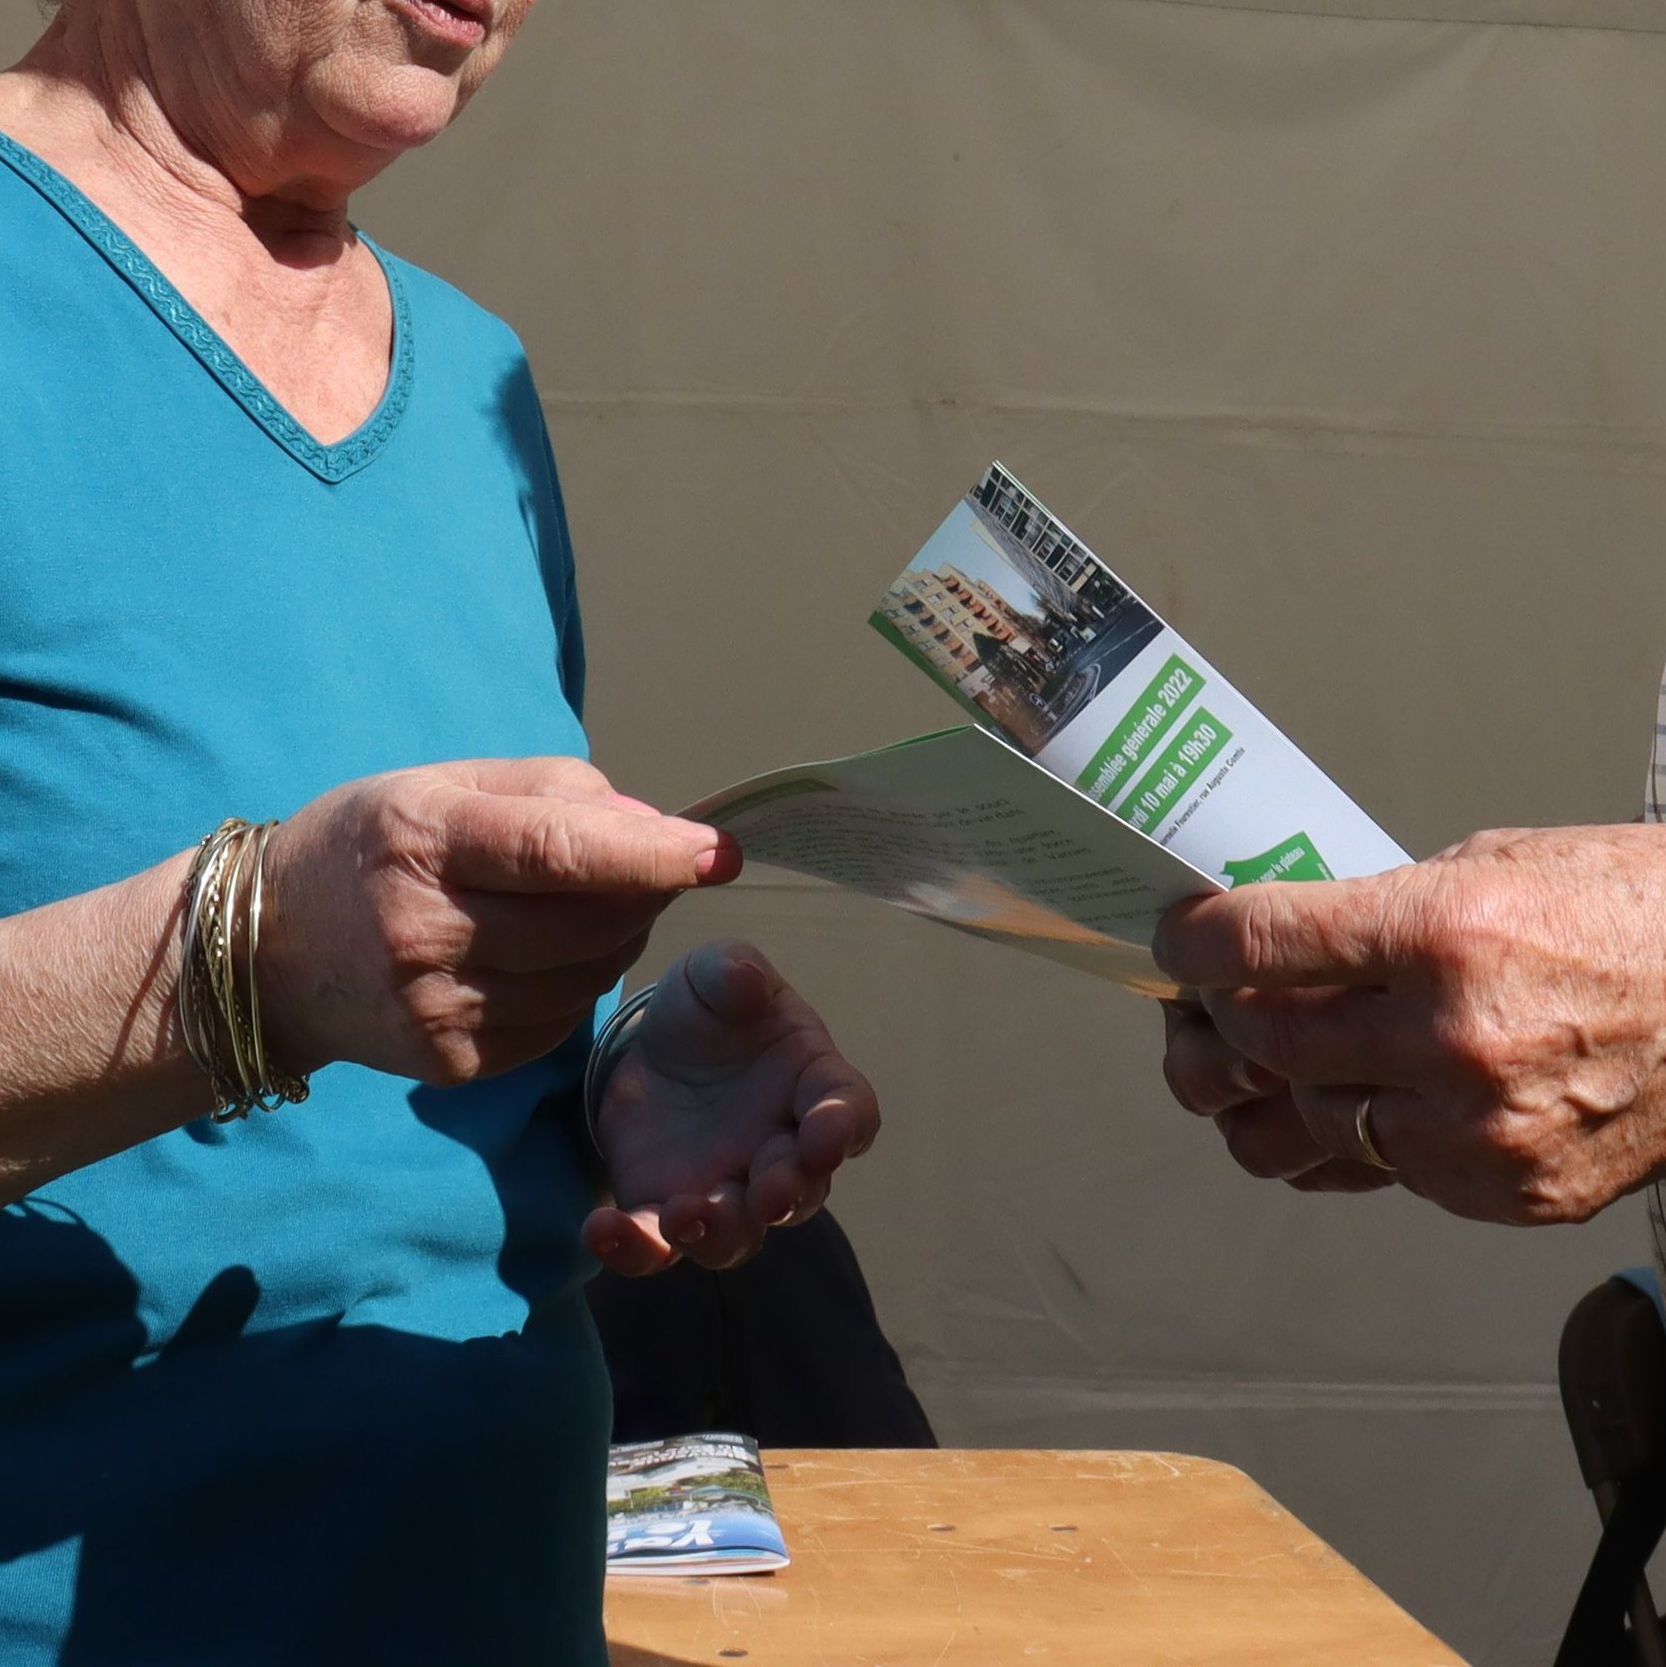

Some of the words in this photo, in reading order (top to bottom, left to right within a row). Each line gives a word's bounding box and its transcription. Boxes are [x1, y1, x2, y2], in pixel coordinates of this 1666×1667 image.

[1121, 701, 1167, 761] générale
[1157, 667, 1194, 709] 2022
[1178, 722, 1217, 768] 19h30
[1154, 769, 1179, 800] mai
[1169, 760, 1188, 778] à
[1139, 791, 1161, 813] 10
